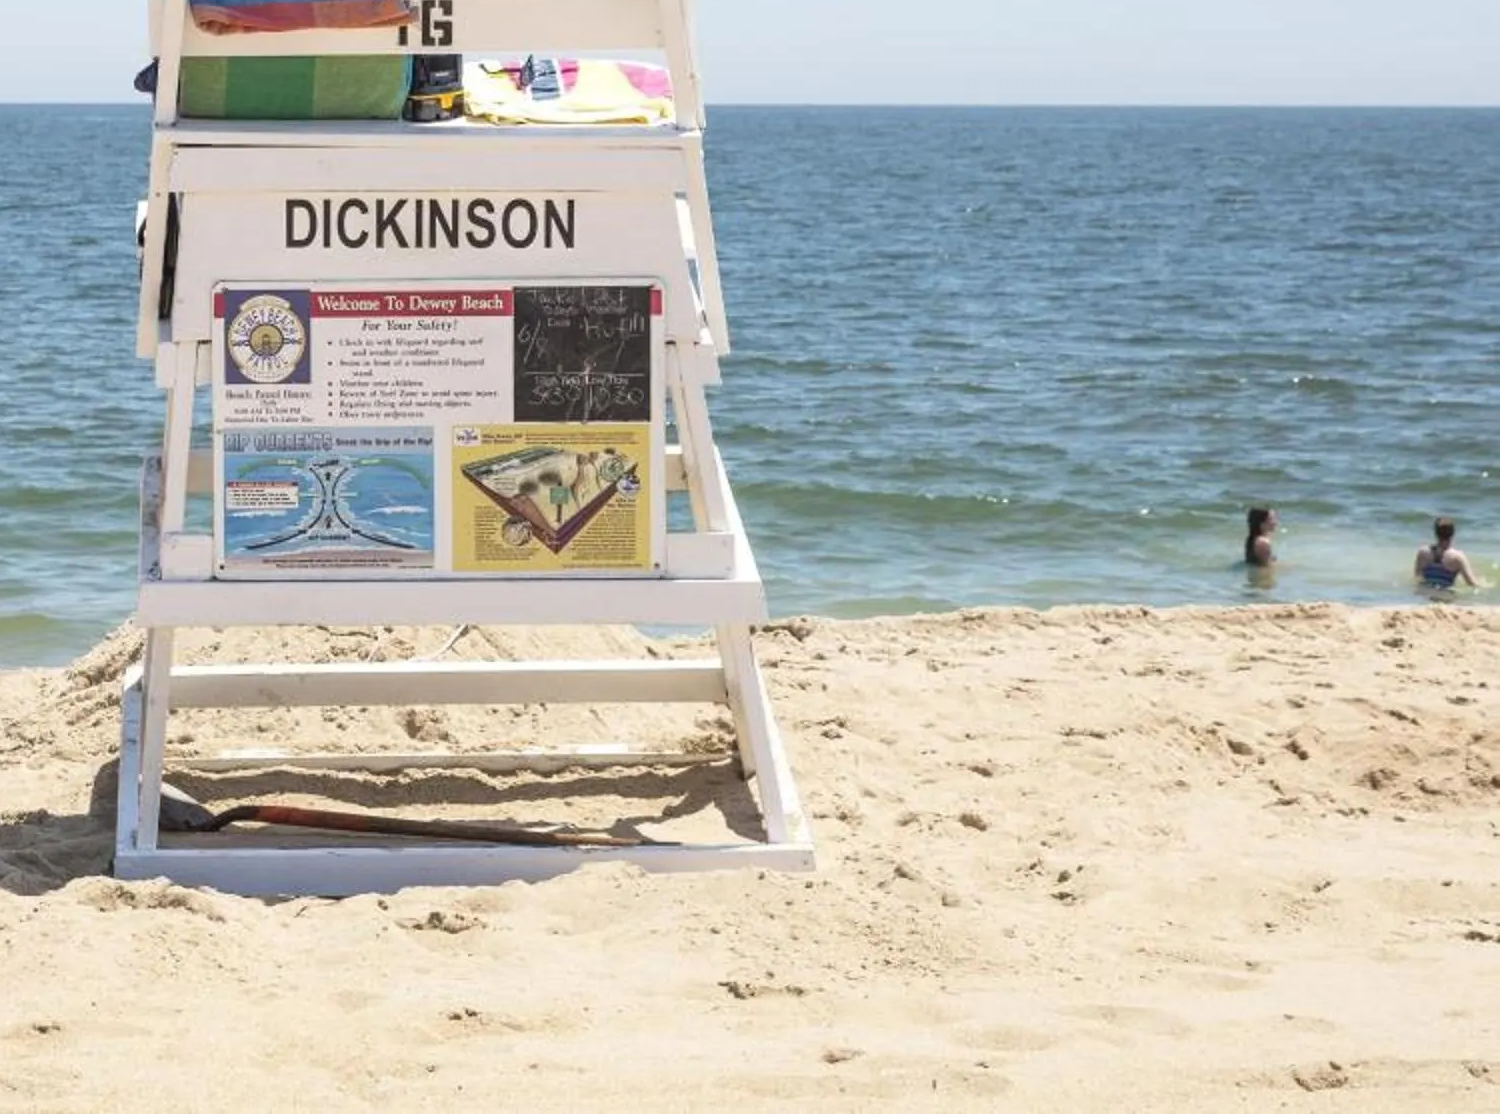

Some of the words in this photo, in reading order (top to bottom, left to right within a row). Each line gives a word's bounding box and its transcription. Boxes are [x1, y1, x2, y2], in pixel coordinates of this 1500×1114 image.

[284, 197, 576, 250] DICKINSON
[317, 295, 381, 311] Welcome
[384, 295, 405, 311] To
[409, 295, 457, 313] Dewey
[461, 294, 504, 311] Beach
[361, 320, 382, 331] For
[386, 320, 413, 331] Your
[415, 319, 459, 332] Safety!
[224, 433, 250, 452] RIP
[253, 432, 333, 451] CURRENTS
[359, 437, 373, 446] the
[393, 437, 401, 446] of
